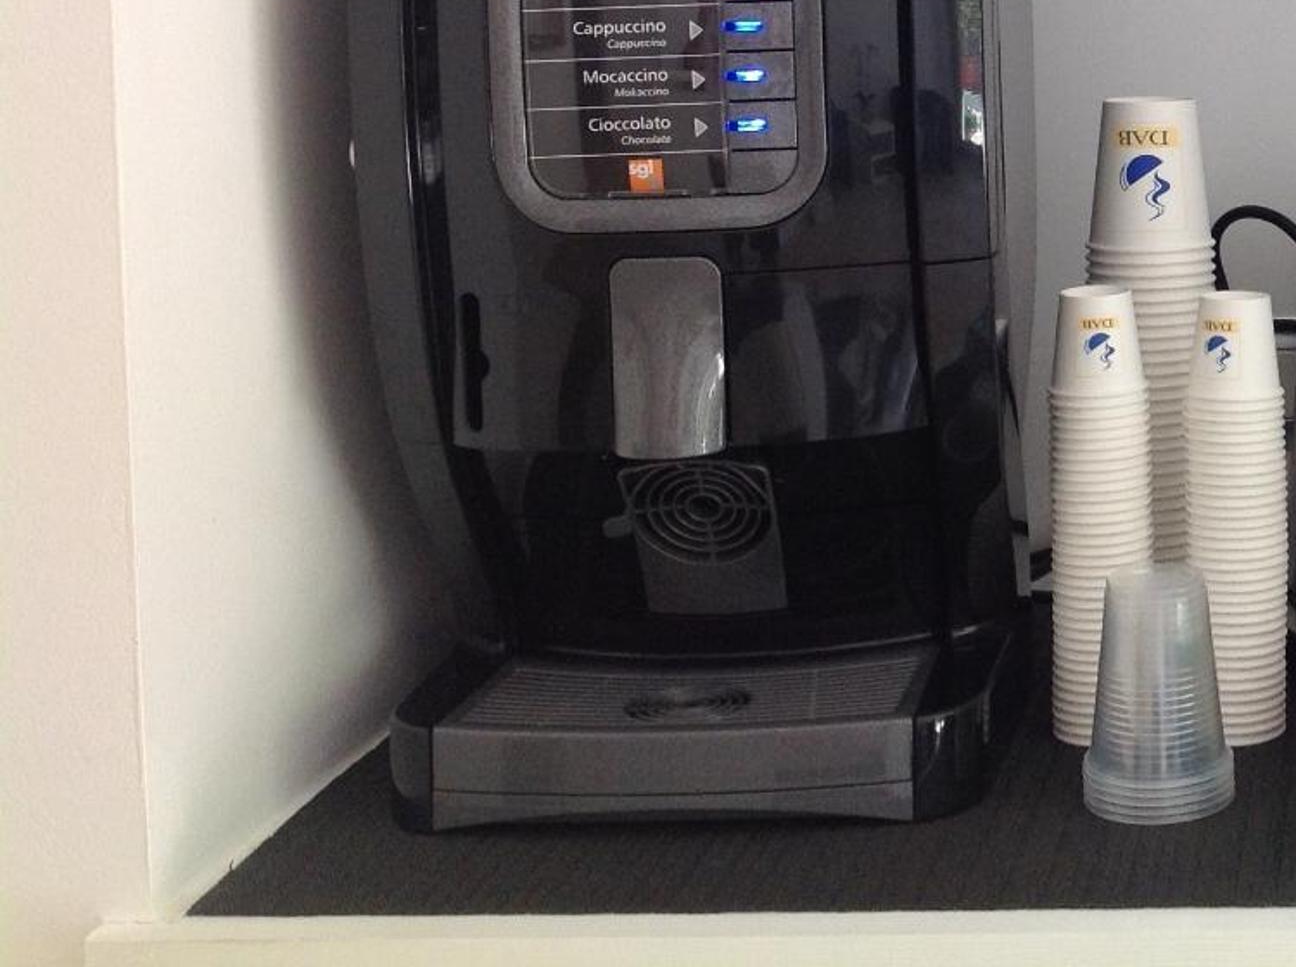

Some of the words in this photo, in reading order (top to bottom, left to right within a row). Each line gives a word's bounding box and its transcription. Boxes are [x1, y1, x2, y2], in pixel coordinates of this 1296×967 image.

[572, 20, 667, 38] Cappuccino
[607, 38, 667, 50] Cappuccino
[583, 68, 669, 84] Mocaccino
[588, 115, 672, 133] Cioccolato
[621, 133, 672, 146] Chocolate
[1118, 129, 1170, 146] DAB
[1082, 319, 1115, 329] DAB
[1204, 321, 1235, 332] DAB
